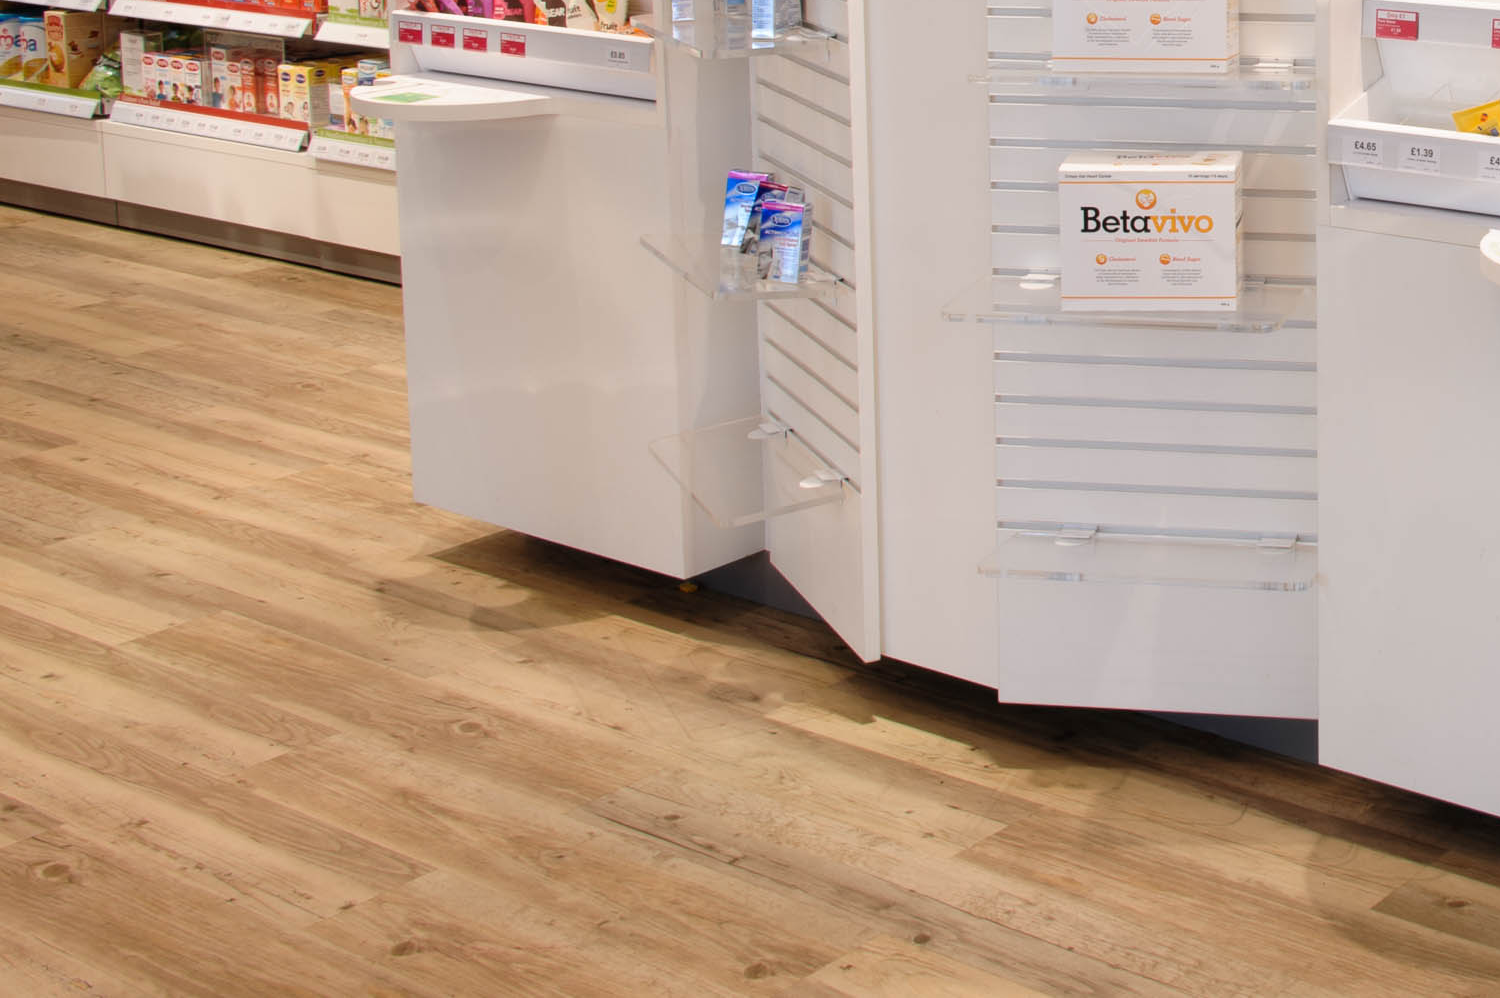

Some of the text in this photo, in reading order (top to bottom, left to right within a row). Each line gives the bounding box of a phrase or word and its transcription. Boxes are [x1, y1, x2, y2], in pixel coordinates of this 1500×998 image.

[1354, 140, 1377, 152] £4.65
[1411, 146, 1434, 158] £1.39
[1080, 206, 1214, 234] Betavivo
